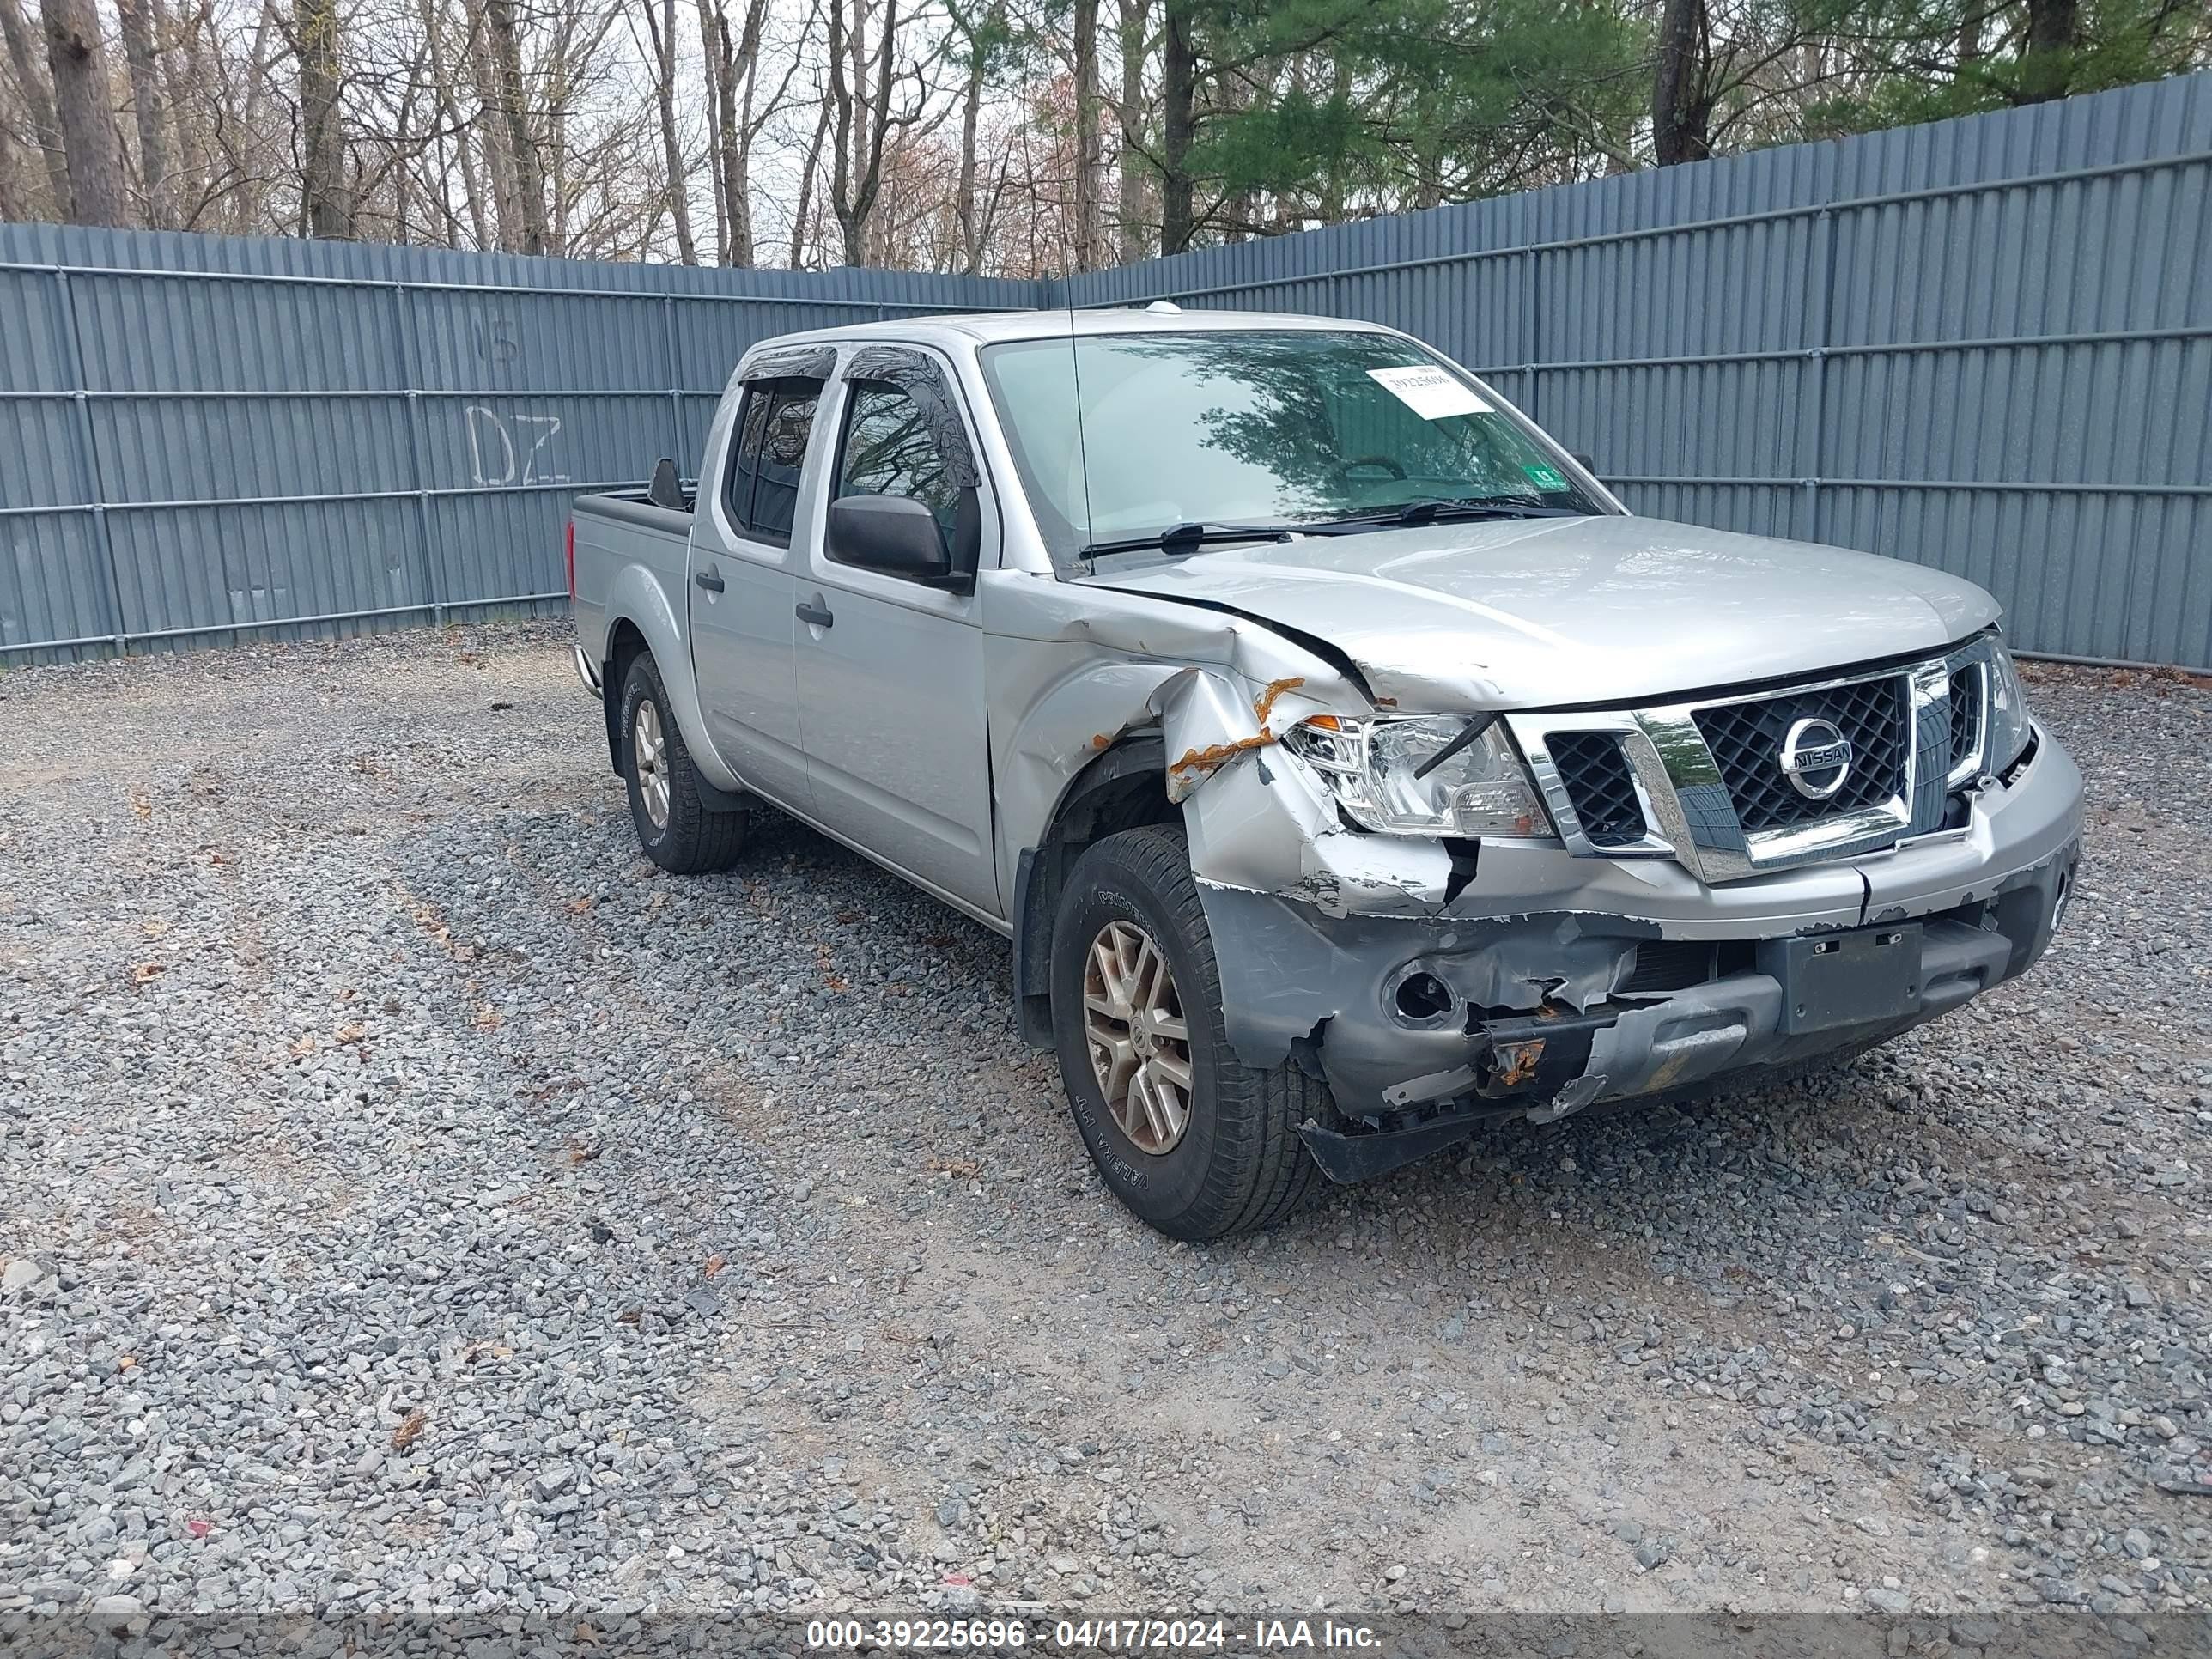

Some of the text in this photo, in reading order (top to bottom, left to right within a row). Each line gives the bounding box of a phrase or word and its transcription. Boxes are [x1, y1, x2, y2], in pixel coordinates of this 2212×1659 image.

[1389, 374, 1451, 390] 39225696
[1794, 746, 1850, 769] NISSAN
[1075, 1095, 1149, 1190] VALERA HT
